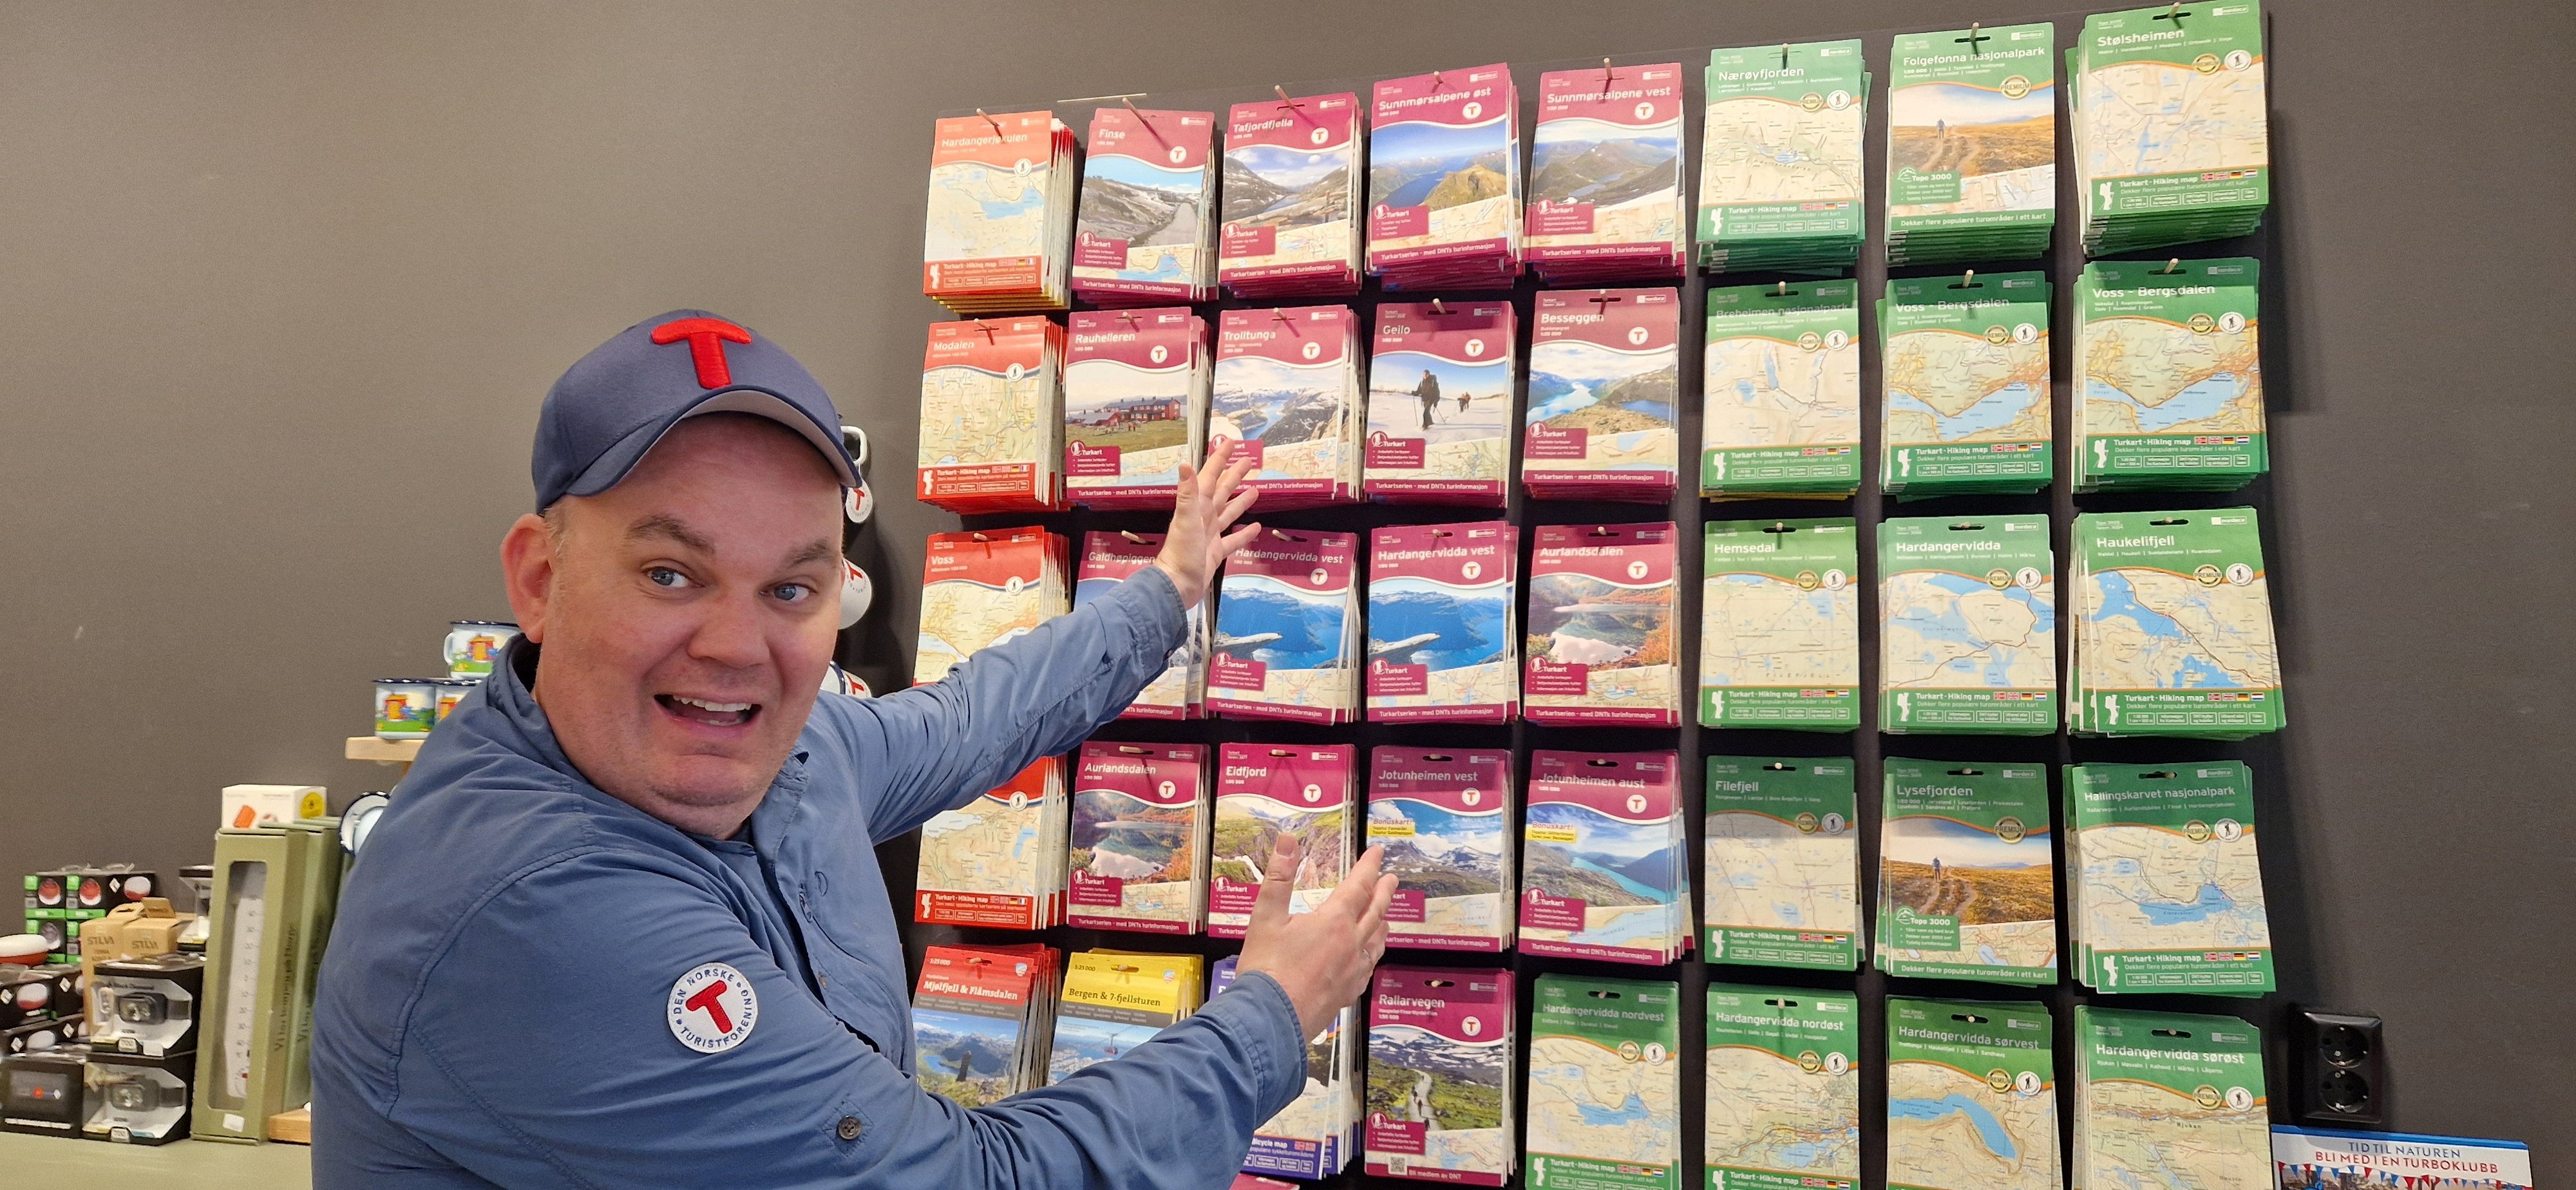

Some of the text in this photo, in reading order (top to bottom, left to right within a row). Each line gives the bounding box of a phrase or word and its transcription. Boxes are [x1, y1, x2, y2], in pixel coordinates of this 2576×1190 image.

[2097, 30, 2184, 47] Stølsheimen
[1904, 46, 2045, 66] Folgefonna nasjonalpark
[1718, 67, 1804, 81] Nærøyfjorden
[1379, 87, 1492, 111] Sunnmørsalpene øst
[1547, 86, 1671, 103] Sunnmørsalpene vest
[1468, 106, 1477, 115] T
[1639, 106, 1649, 116] T
[1233, 118, 1293, 134] Tafjordfjella
[942, 133, 1028, 147] Hardangerjøkulen
[1099, 129, 1126, 140] Finse
[1315, 131, 1323, 140] T
[1173, 150, 1182, 158] T
[1943, 217, 1975, 225] populære
[2092, 288, 2125, 299] Voss
[2138, 285, 2215, 298] Bergsdalen
[1716, 303, 1848, 319] Breheimen nasjonalpark
[1896, 303, 1925, 313] Voss
[1938, 298, 2009, 311] Bergsdalen
[1541, 313, 1604, 325] Besseggen
[1383, 324, 1411, 335] Geilo
[1075, 333, 1136, 344] Rauhelleren
[1224, 330, 1276, 342] Trolltunga
[1634, 332, 1643, 341] T
[933, 341, 974, 351] Modalen
[1307, 346, 1316, 355] T
[1470, 343, 1479, 353] T
[650, 317, 752, 390] T
[1154, 350, 1163, 359] T
[1446, 483, 1488, 491] turinformasjon
[1896, 541, 2001, 552] Hardangervidda
[2096, 535, 2175, 549] Haukelifjell
[1378, 545, 1495, 562] Hardangervidda vest
[1540, 547, 1624, 557] Aurlandsdalen
[1714, 543, 1776, 554] Hemsedal
[931, 554, 954, 565] Voss
[1235, 549, 1344, 564] Hardangervidda vest
[1466, 565, 1477, 575] T
[1633, 566, 1643, 576] T
[1314, 572, 1324, 581] T
[2125, 694, 2154, 703] Turkart
[2159, 694, 2184, 703] Hiking
[1084, 762, 1156, 775] Aurlandsdalen
[1226, 766, 1267, 778] Eidfjord
[1379, 770, 1479, 782] Jotunheimen vest
[1539, 773, 1645, 789] Jotunheimen aust
[1162, 786, 1171, 795] T
[1716, 780, 1759, 793] Filefjell
[1897, 785, 1973, 797] Lysefjorden
[1307, 789, 1317, 798] T
[1466, 791, 1476, 802] T
[2085, 786, 2235, 802] Hallingskarvet nasjonalpark
[1631, 799, 1642, 809] T
[1531, 942, 1571, 952] Turkartserien
[1607, 949, 1653, 961] turinformasjon
[2156, 954, 2182, 963] Hiking
[1943, 967, 1975, 976] populære
[1976, 968, 2016, 977] turområder
[674, 968, 735, 1014] DEN NORSKE
[923, 981, 960, 993] Mjølfjell
[969, 986, 1018, 1001] Flåmsdalen
[1068, 988, 1098, 1000] Bergen
[1110, 992, 1160, 1006] 7-fjellsturen
[685, 979, 733, 1034] T
[1379, 994, 1445, 1010] Rallarvegen
[1542, 1003, 1665, 1022] Hardangervidda nordvest
[680, 990, 752, 1048] TURISTFORENING
[1716, 1012, 1844, 1031] Hardangervidda nordøst
[1467, 1021, 1476, 1032] T
[1899, 1025, 1991, 1044] Hardangervidda
[1995, 1037, 2039, 1050] sørvest
[2096, 1044, 2245, 1064] Hardangervidda sørøst
[2348, 1141, 2461, 1158] TID TIL NATUREN
[2315, 1151, 2336, 1162] BLI
[2339, 1153, 2371, 1164] MED
[2382, 1156, 2400, 1166] EN
[2403, 1158, 2498, 1174] TURBOKLUBB
